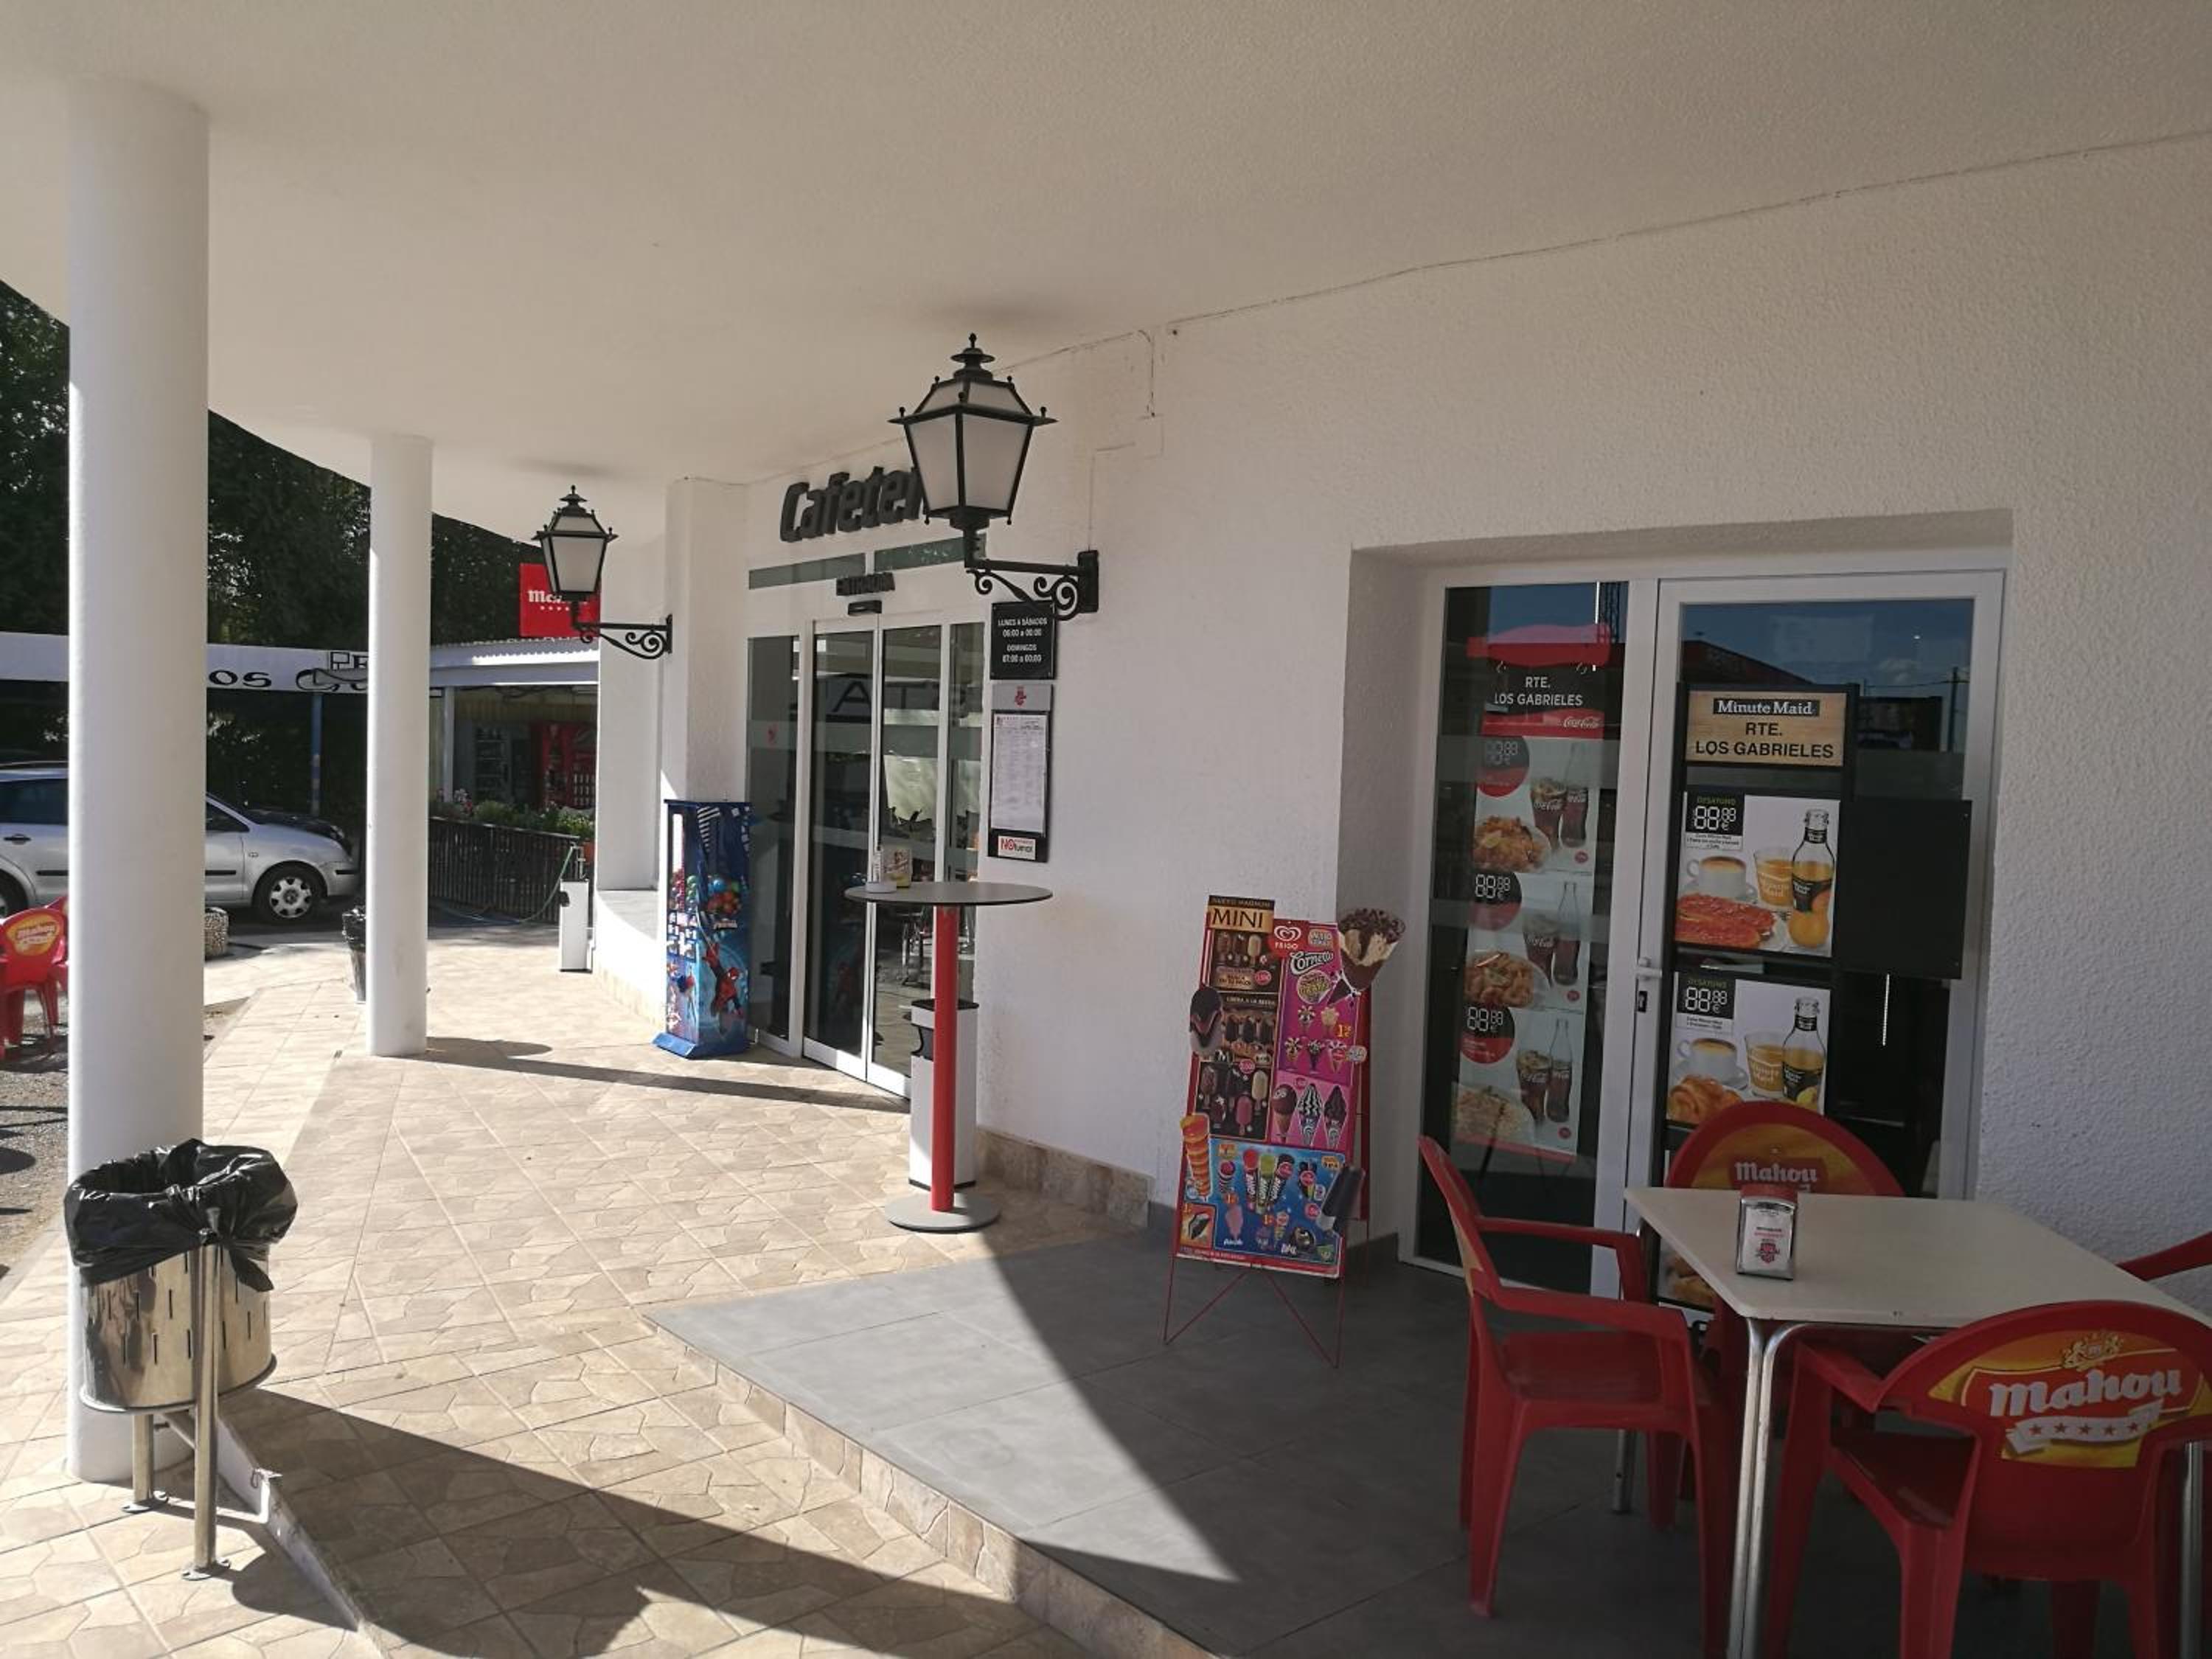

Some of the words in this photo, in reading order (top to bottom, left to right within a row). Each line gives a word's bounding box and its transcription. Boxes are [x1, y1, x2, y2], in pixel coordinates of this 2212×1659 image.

[779, 466, 925, 542] Cafeter
[1006, 644, 1037, 652] DOMINGOS
[1526, 676, 1551, 688] RTE.
[1517, 694, 1584, 706] GABRIELES
[1718, 700, 1770, 714] Minute
[1773, 701, 1813, 714] Maid
[1745, 722, 1783, 737] RTE.
[1696, 740, 1729, 755] LOS
[1734, 741, 1834, 759] GABRIELES
[1212, 908, 1263, 928] MINI
[1275, 942, 1298, 950] FRIGO
[1734, 1161, 1818, 1183] Mahou
[1989, 1368, 2182, 1417] Mahou
